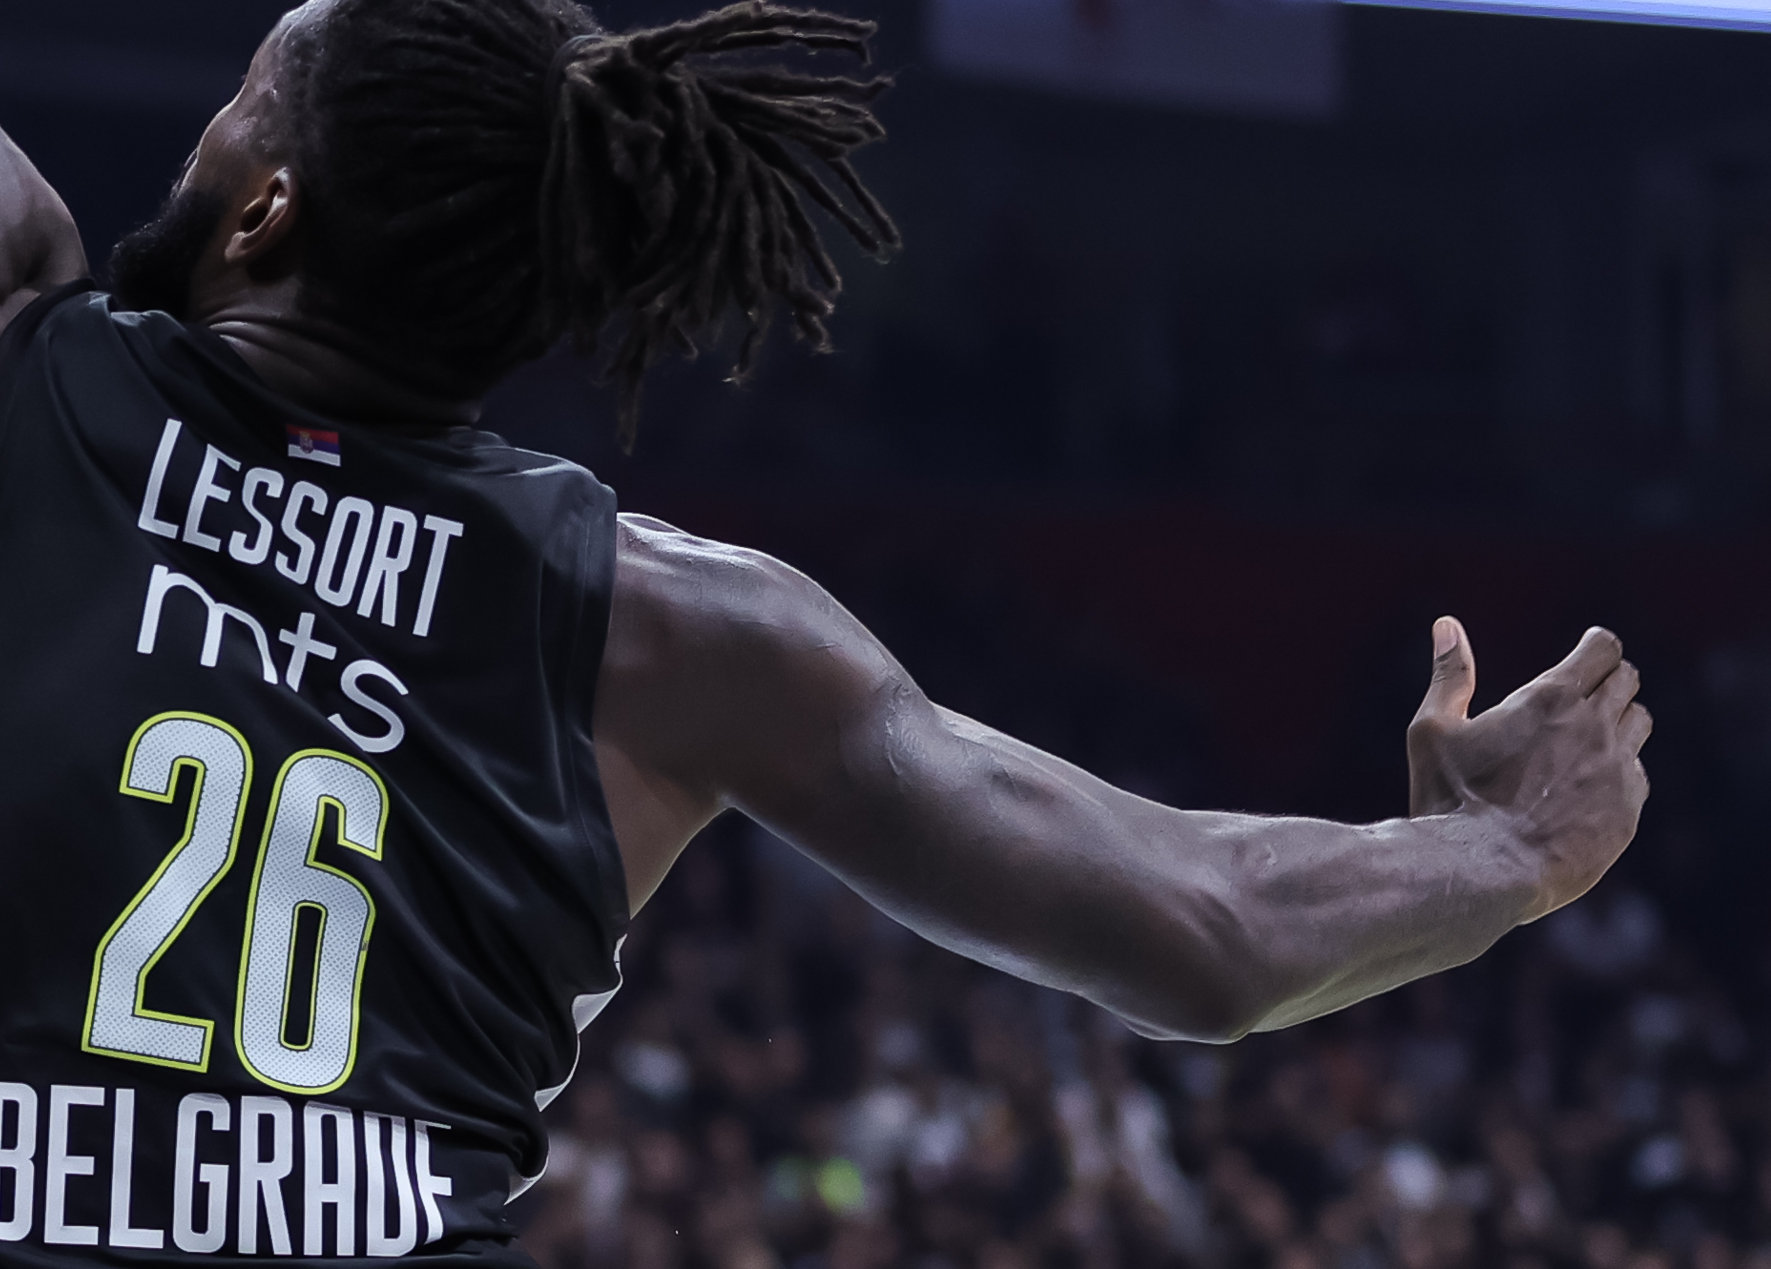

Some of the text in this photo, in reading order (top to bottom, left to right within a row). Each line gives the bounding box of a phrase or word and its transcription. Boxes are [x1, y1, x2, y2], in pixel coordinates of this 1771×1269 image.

[137, 418, 464, 637] LESSORT
[136, 563, 409, 753] mts
[81, 710, 389, 1096] 26
